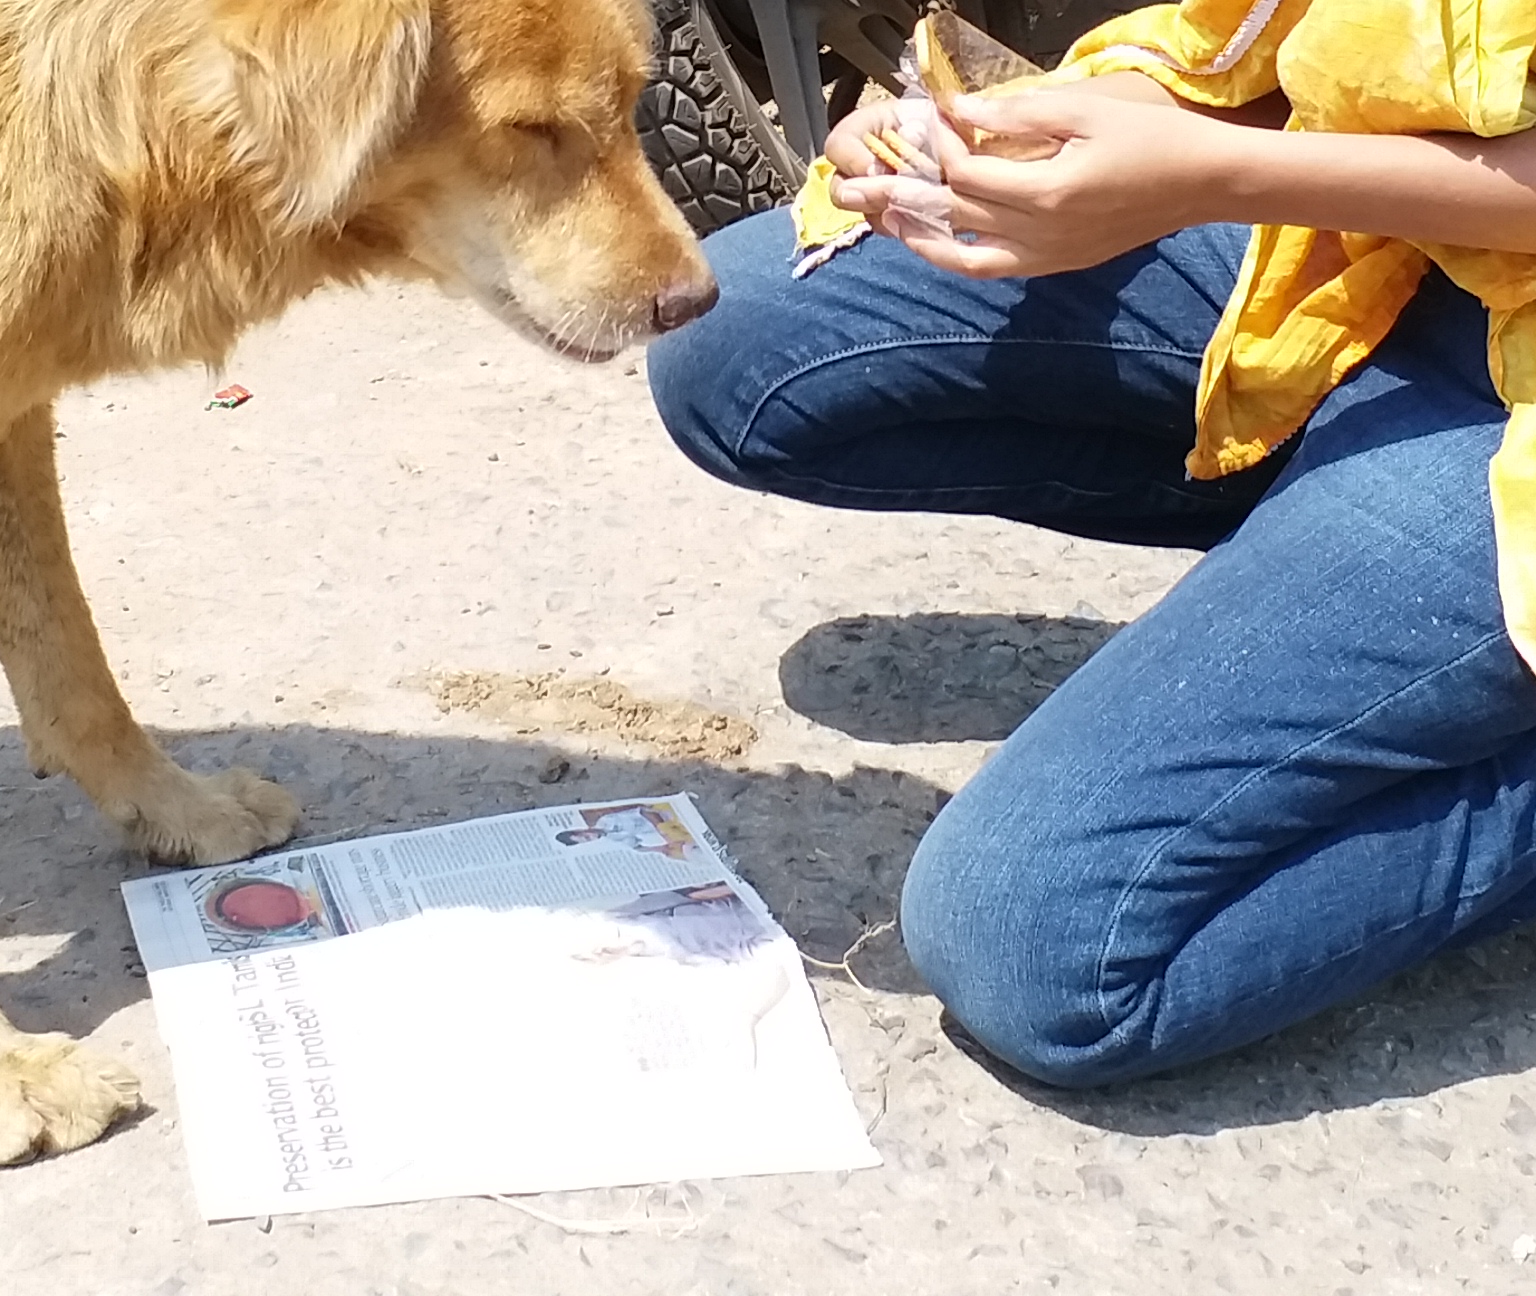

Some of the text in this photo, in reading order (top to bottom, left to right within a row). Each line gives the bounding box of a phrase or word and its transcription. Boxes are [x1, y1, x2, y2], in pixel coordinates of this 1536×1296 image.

[252, 1051, 286, 1069] of
[303, 1074, 339, 1120] best
[264, 1075, 314, 1192] Preservation
[315, 1123, 349, 1153] the
[321, 1155, 354, 1172] is
